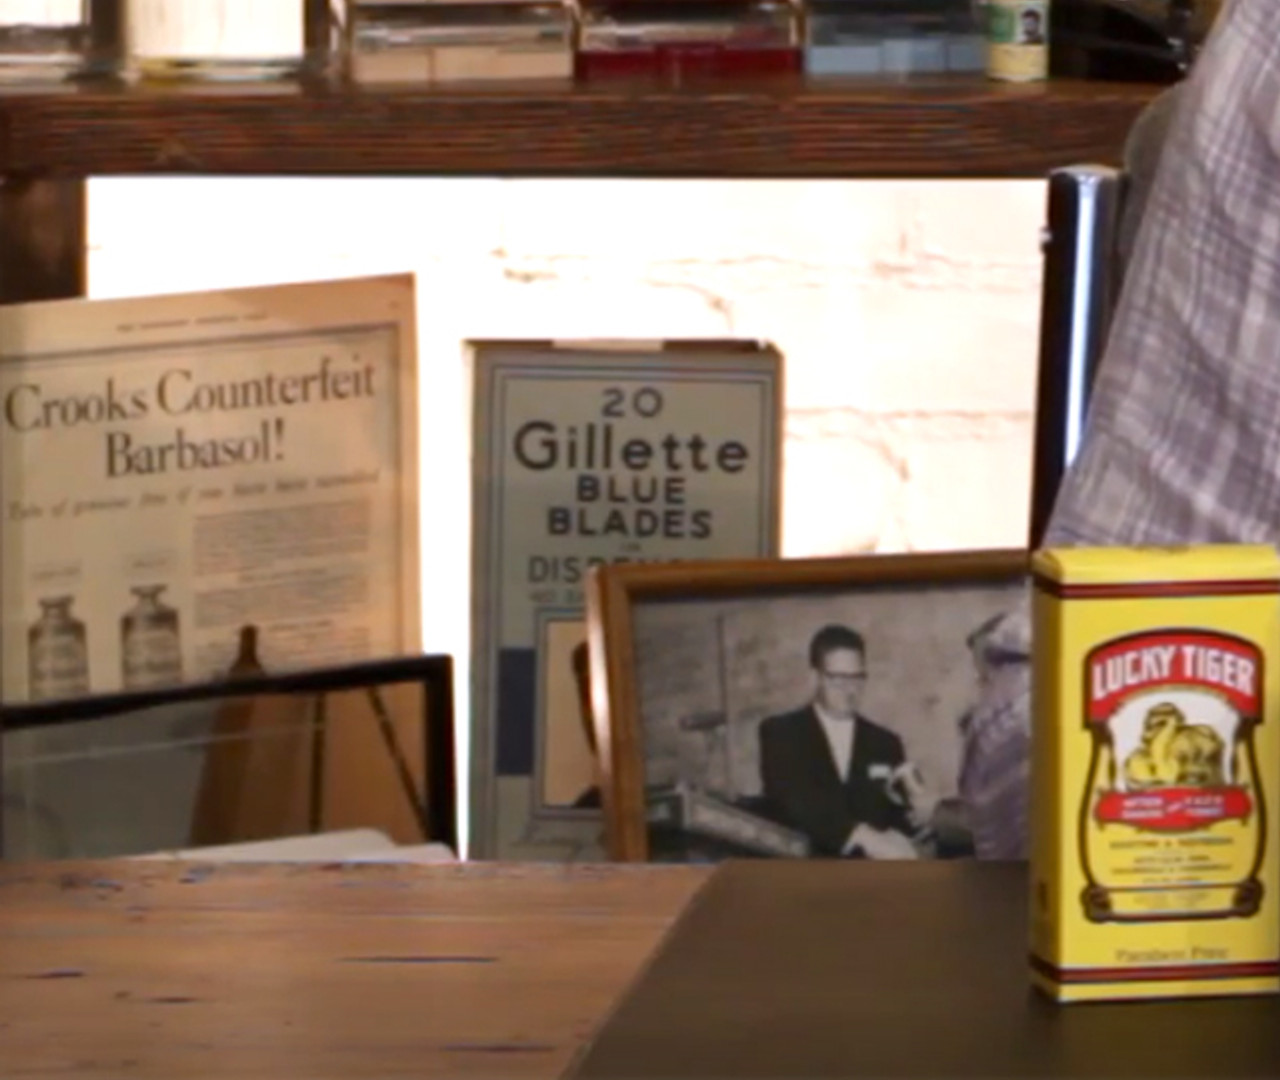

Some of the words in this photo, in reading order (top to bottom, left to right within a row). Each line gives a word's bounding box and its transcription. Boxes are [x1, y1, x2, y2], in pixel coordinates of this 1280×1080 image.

[5, 377, 148, 434] Crooks
[157, 353, 376, 416] Counterfeit
[601, 386, 665, 419] 20
[106, 417, 285, 479] Barbasol!
[513, 420, 750, 473] Gillette
[576, 475, 687, 504] BLUE
[547, 507, 713, 540] BLADES
[1093, 645, 1177, 700] LUCKY
[1181, 644, 1257, 697] TIGER
